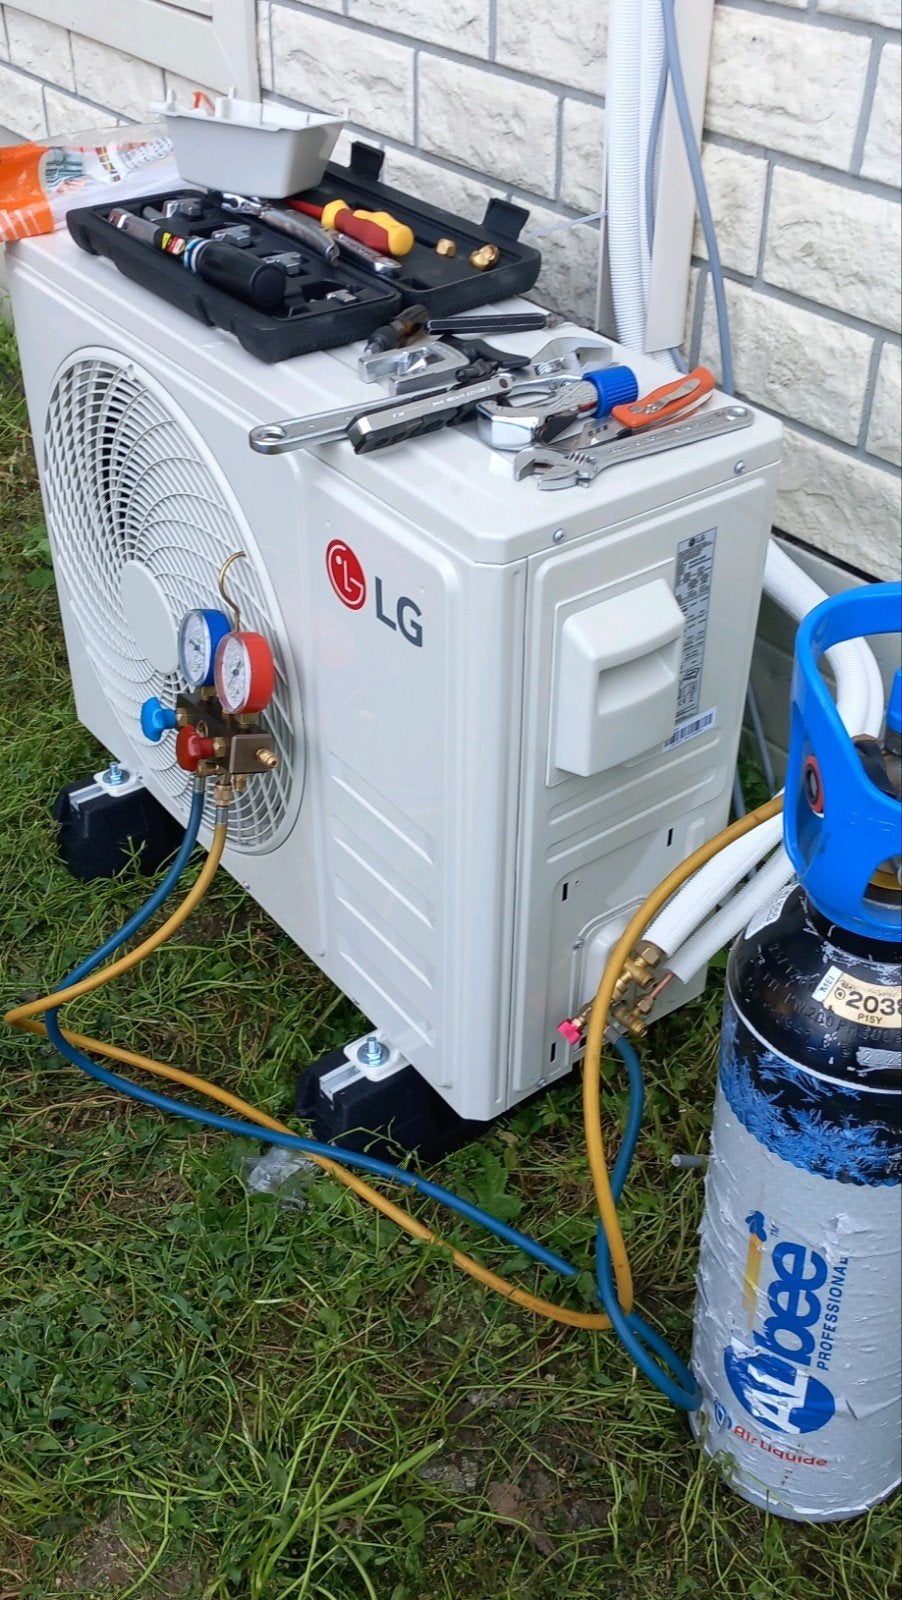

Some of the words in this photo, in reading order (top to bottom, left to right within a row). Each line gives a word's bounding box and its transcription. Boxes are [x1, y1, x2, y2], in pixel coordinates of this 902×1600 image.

[374, 576, 423, 647] LG
[845, 990, 901, 1016] 203
[857, 1013, 883, 1025] P15Y
[817, 1256, 850, 1371] PROFESSIONAL
[733, 1425, 758, 1444] Air
[759, 1440, 828, 1466] Liquide
